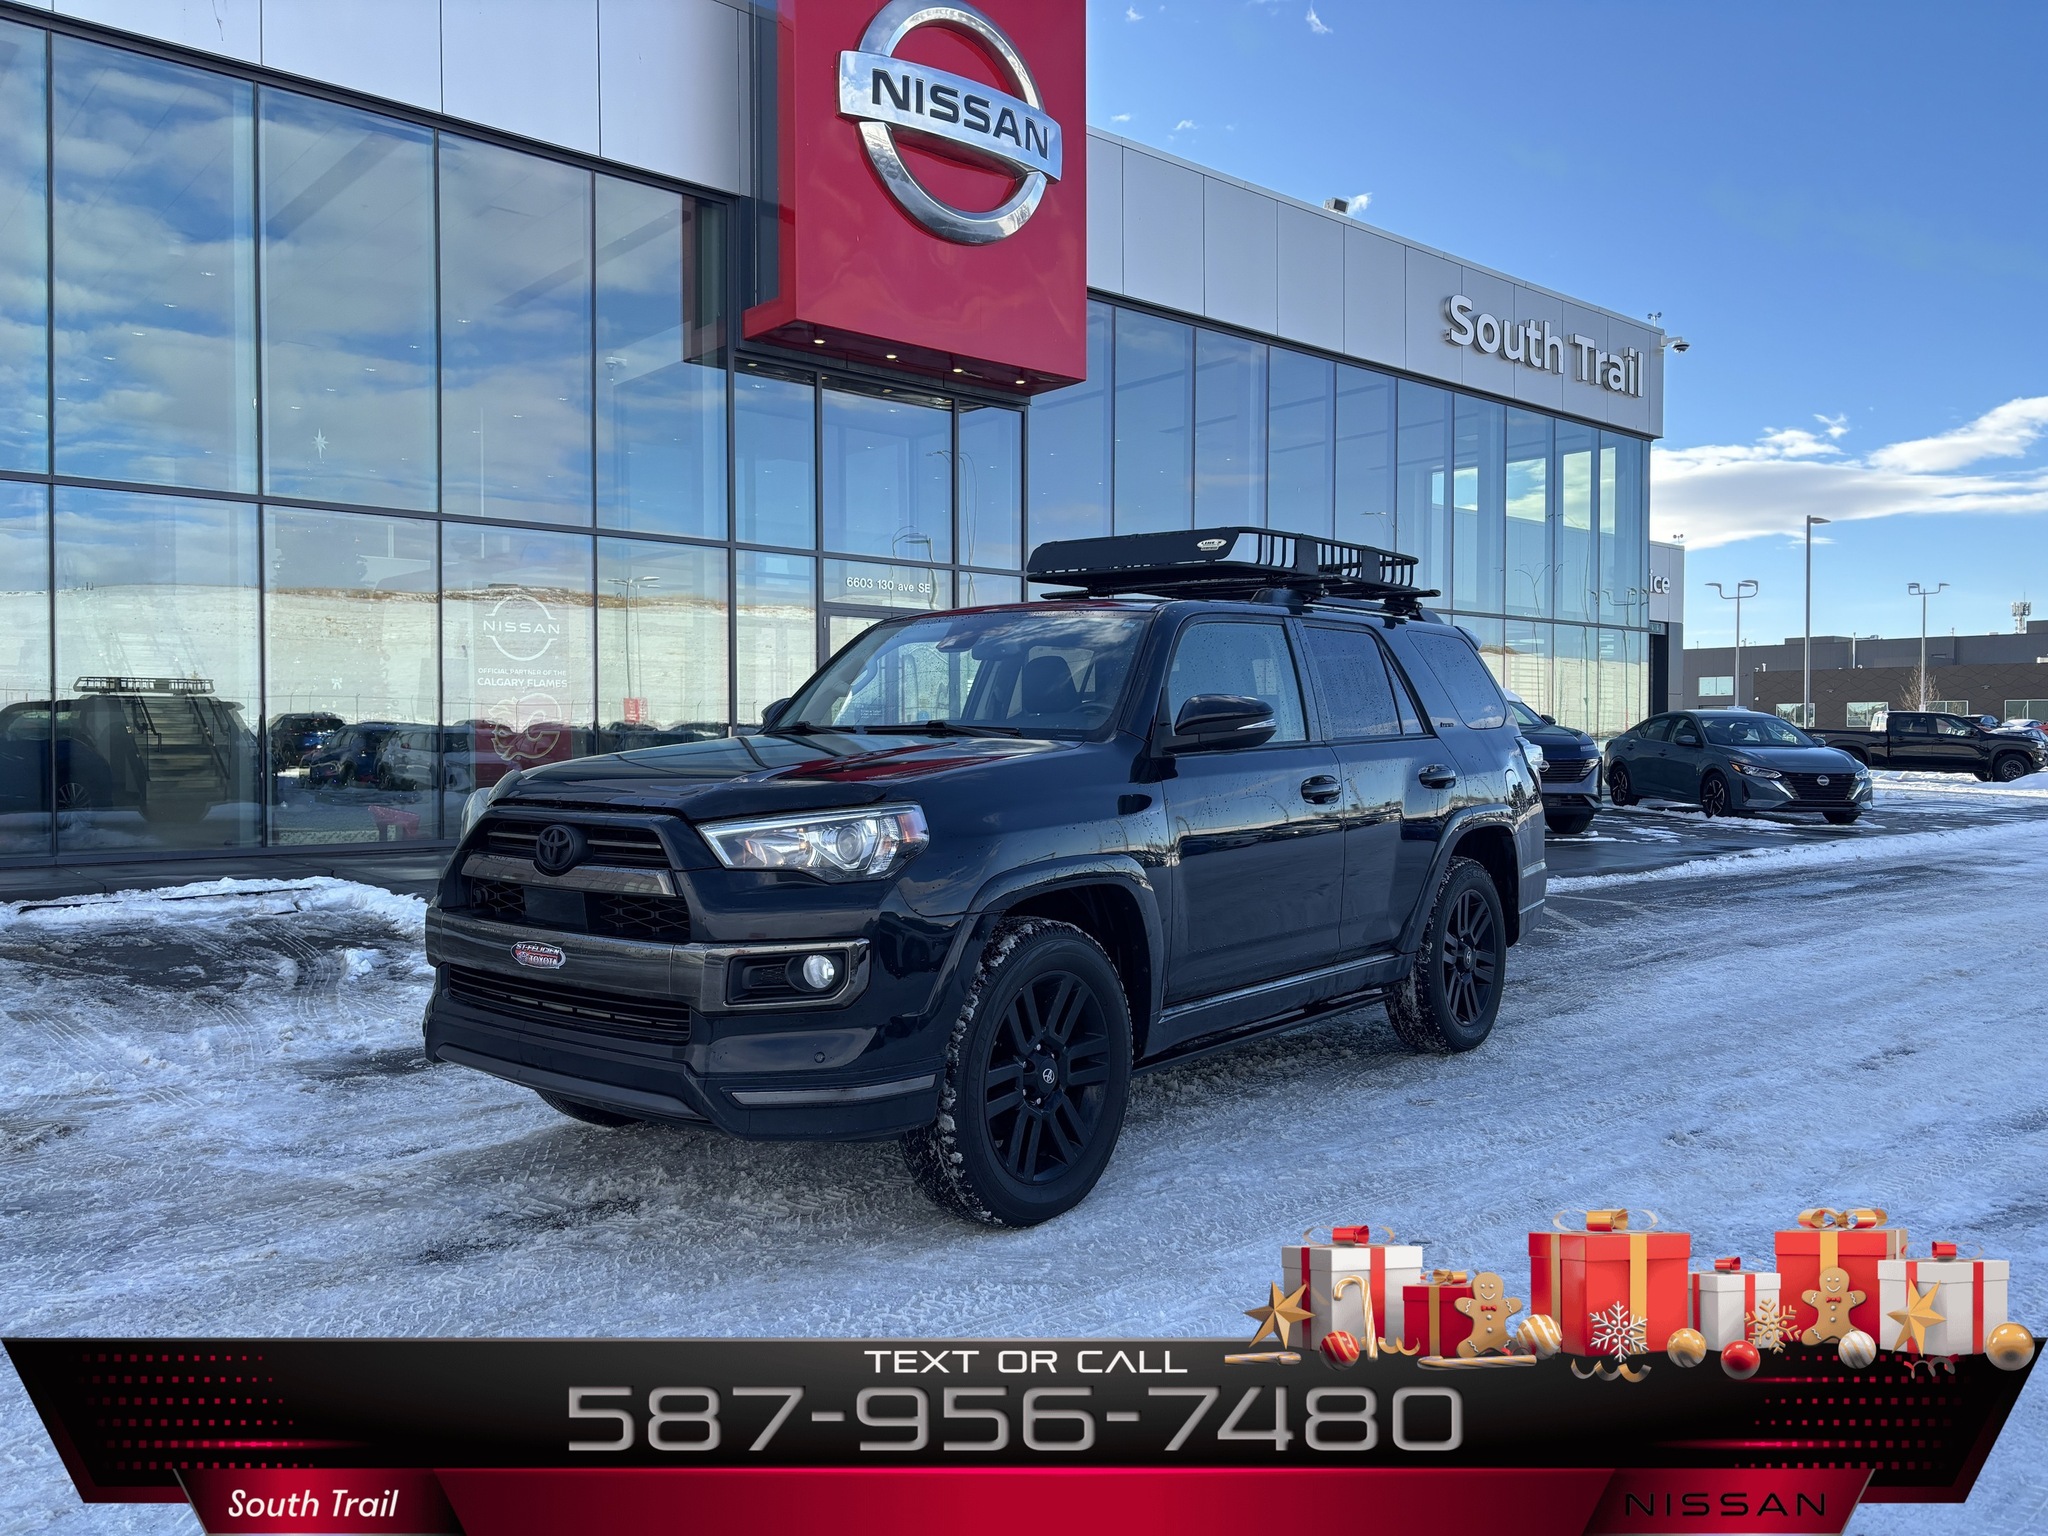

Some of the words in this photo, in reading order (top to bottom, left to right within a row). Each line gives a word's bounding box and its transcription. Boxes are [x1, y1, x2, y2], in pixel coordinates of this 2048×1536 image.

[871, 67, 1049, 160] NISSAN
[1446, 294, 1564, 375] South
[1571, 333, 1645, 397] Trail
[846, 577, 873, 589] 6603
[877, 579, 894, 591] 130
[897, 583, 915, 593] ave
[918, 582, 931, 594] SE
[483, 620, 560, 635] NISSAN
[478, 667, 508, 675] OFFICIAL
[510, 668, 541, 676] PARTNER
[477, 677, 525, 687] CALGARY
[527, 679, 568, 688] FLAMES
[529, 955, 558, 966] TOYOTA
